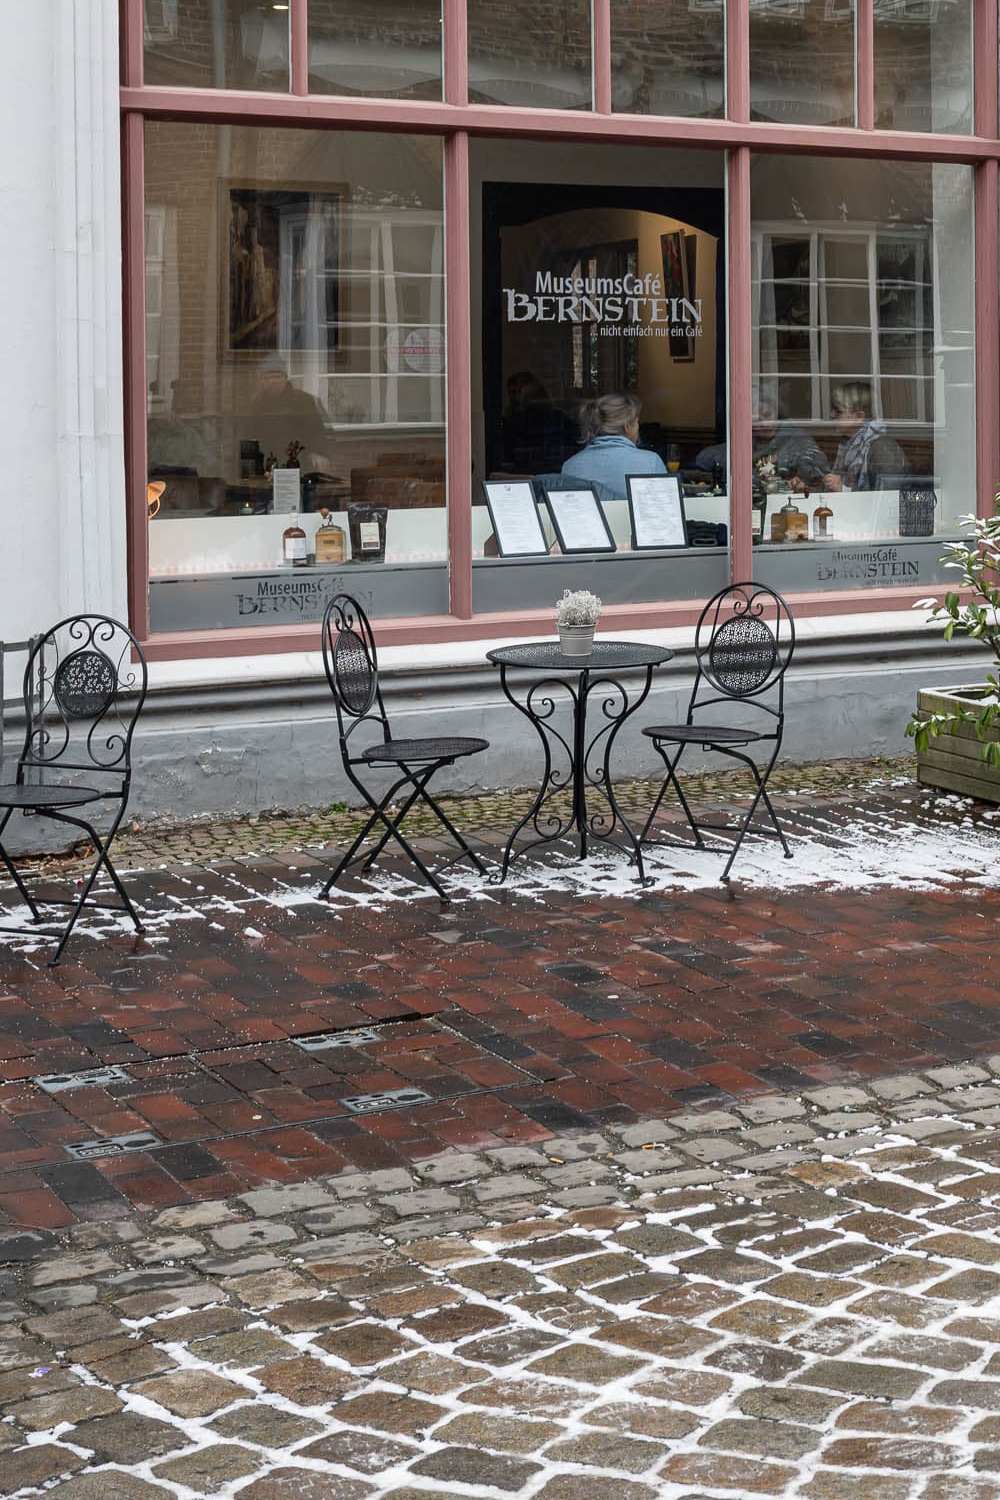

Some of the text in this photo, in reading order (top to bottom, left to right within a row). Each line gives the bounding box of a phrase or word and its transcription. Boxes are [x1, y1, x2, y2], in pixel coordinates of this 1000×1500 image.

[535, 270, 662, 296] MuseumsCafé
[502, 288, 703, 324] BERNSTEIN
[600, 325, 622, 338] nicht
[623, 325, 654, 338] einfach
[655, 328, 669, 338] nur
[670, 326, 684, 338] ein
[685, 325, 704, 338] Café
